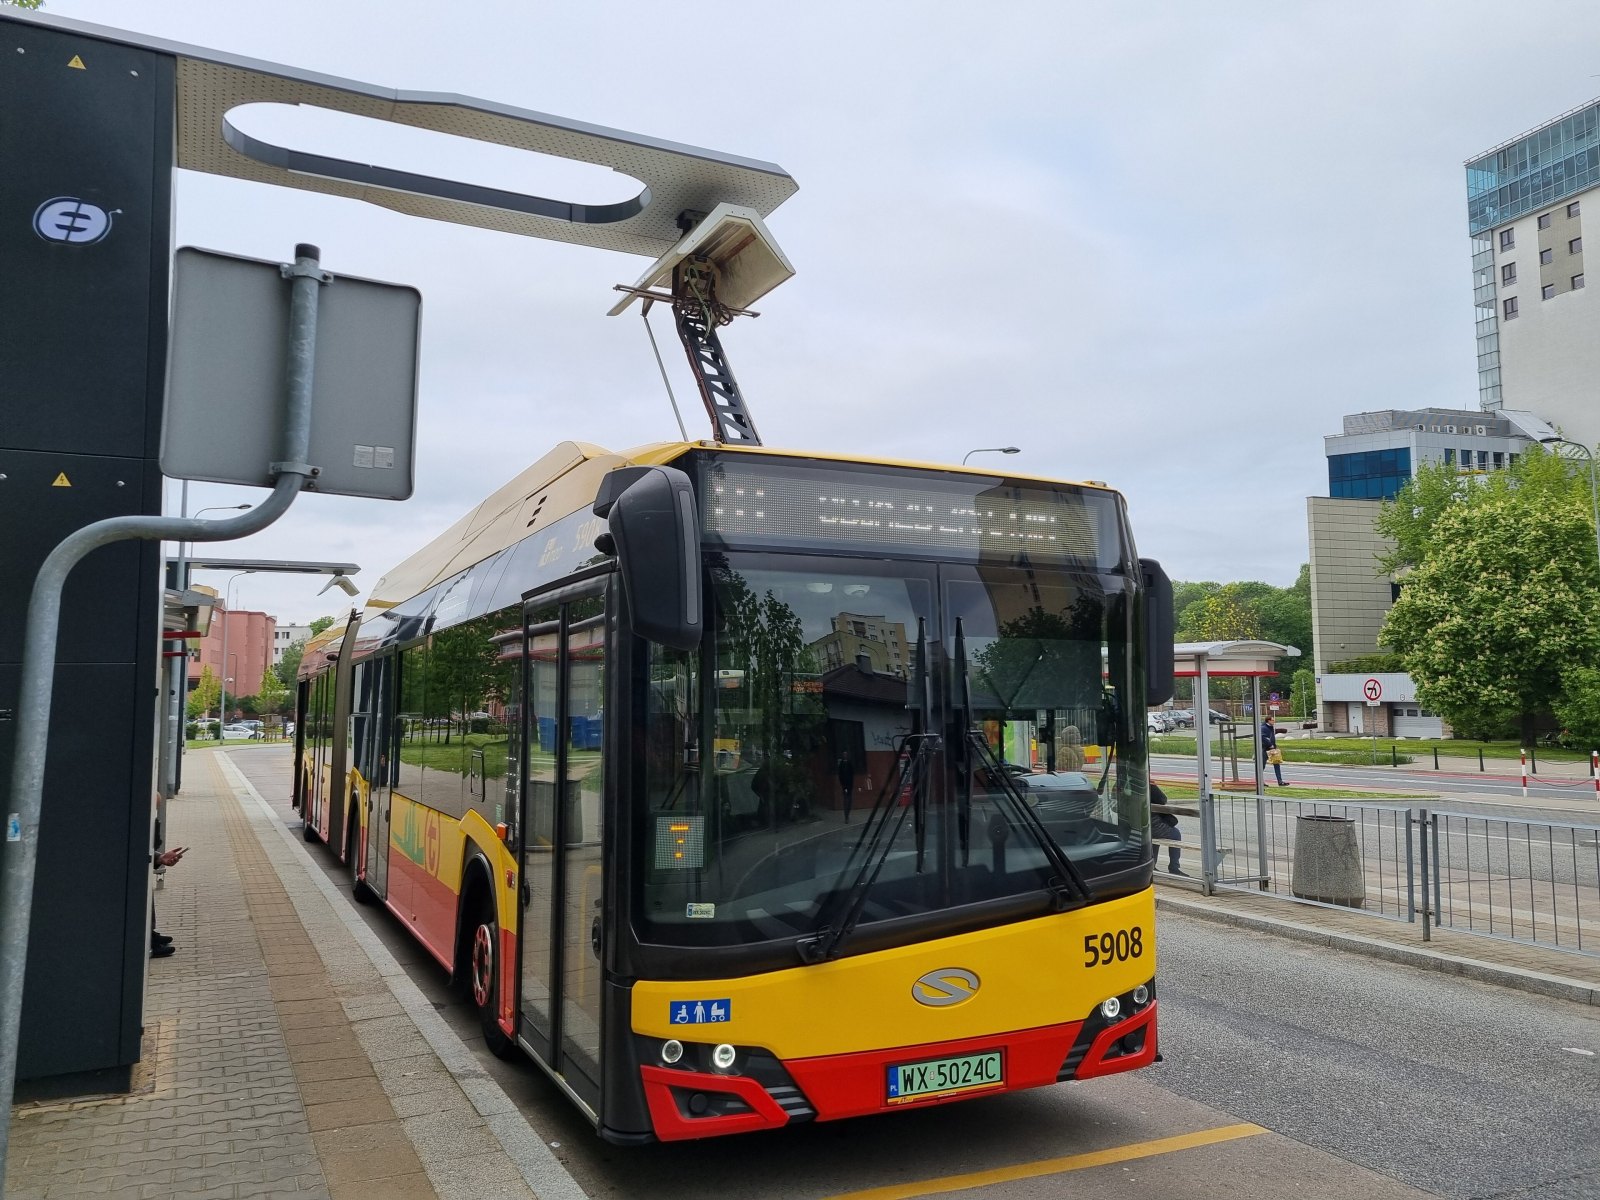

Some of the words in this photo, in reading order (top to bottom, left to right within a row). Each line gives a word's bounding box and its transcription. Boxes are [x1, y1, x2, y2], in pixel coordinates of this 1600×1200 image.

[1083, 926, 1143, 968] 5908
[902, 1065, 929, 1092] WX
[937, 1057, 996, 1087] 5024C
